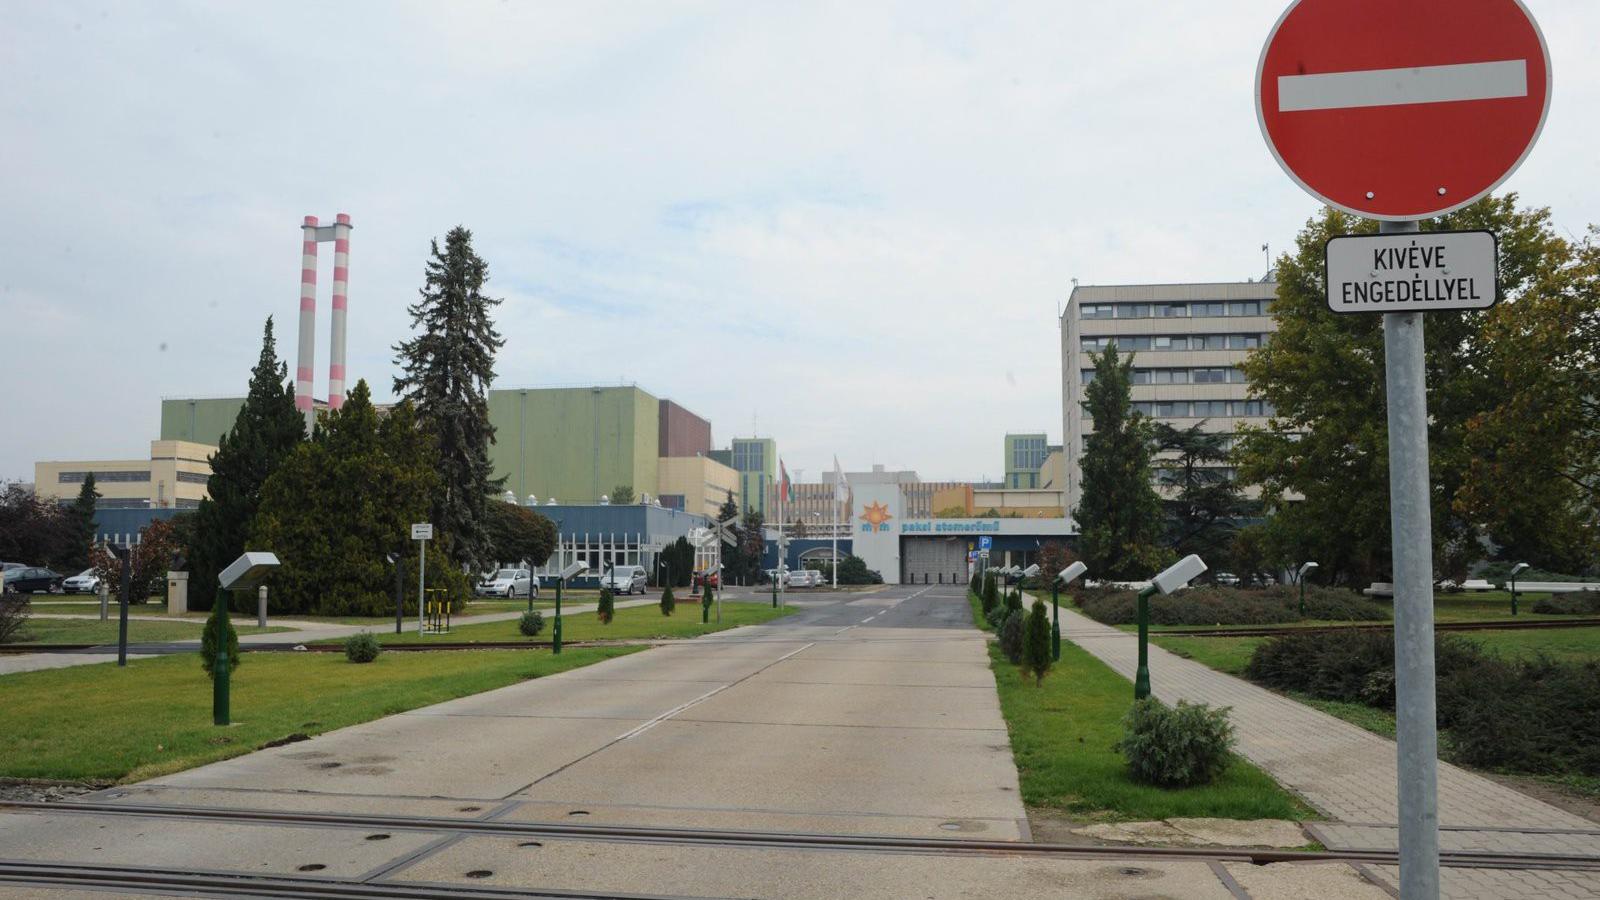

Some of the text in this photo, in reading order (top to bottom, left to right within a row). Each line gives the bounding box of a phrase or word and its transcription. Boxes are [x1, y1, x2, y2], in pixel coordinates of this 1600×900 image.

[1374, 240, 1446, 270] KIVÉVE
[1342, 273, 1481, 304] ENGEDÉLLYEL
[902, 522, 931, 533] paksi
